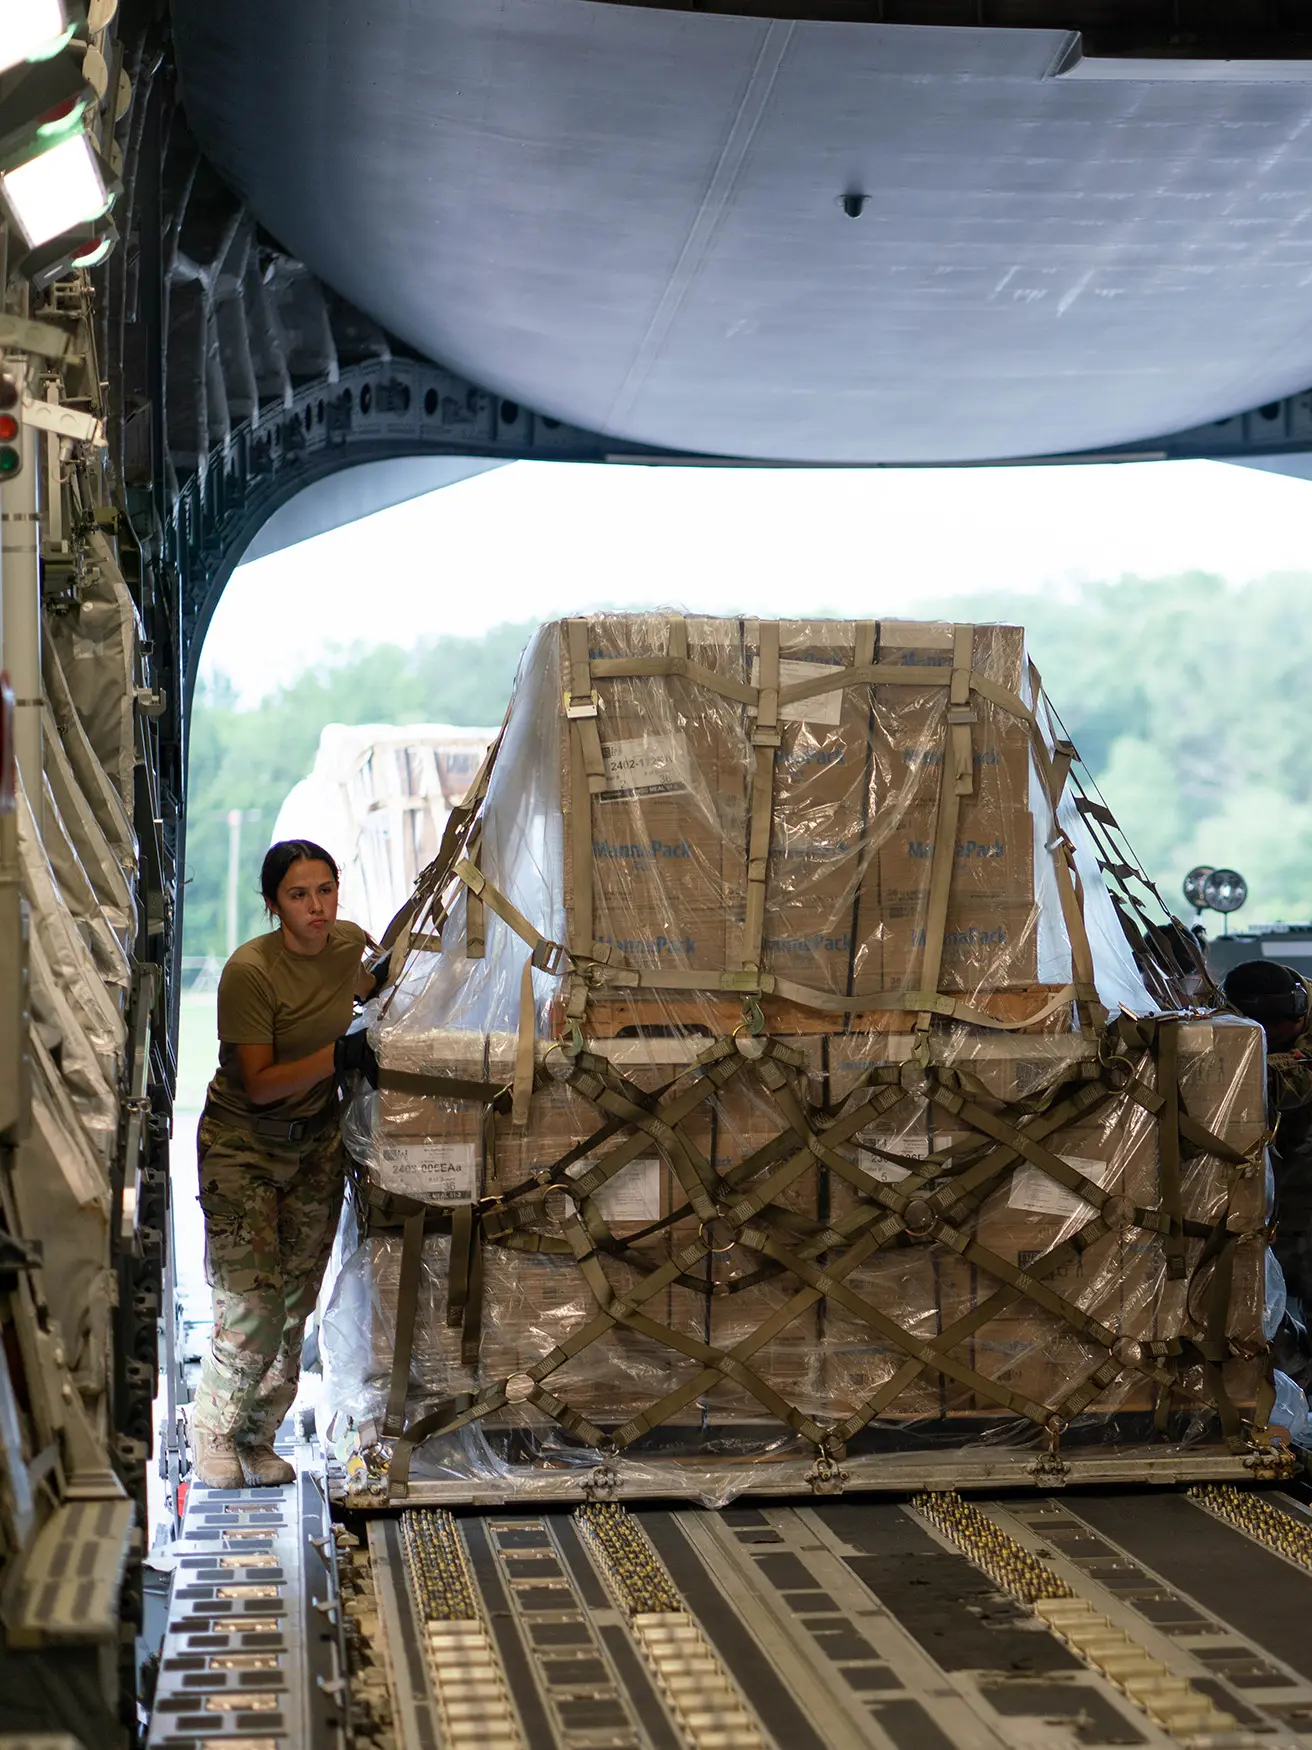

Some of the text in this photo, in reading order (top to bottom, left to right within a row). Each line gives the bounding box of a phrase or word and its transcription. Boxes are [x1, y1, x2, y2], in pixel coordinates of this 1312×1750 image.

[908, 839, 1004, 859] MaaPack
[881, 1172, 888, 1182] 5
[443, 1181, 456, 1191] 36
